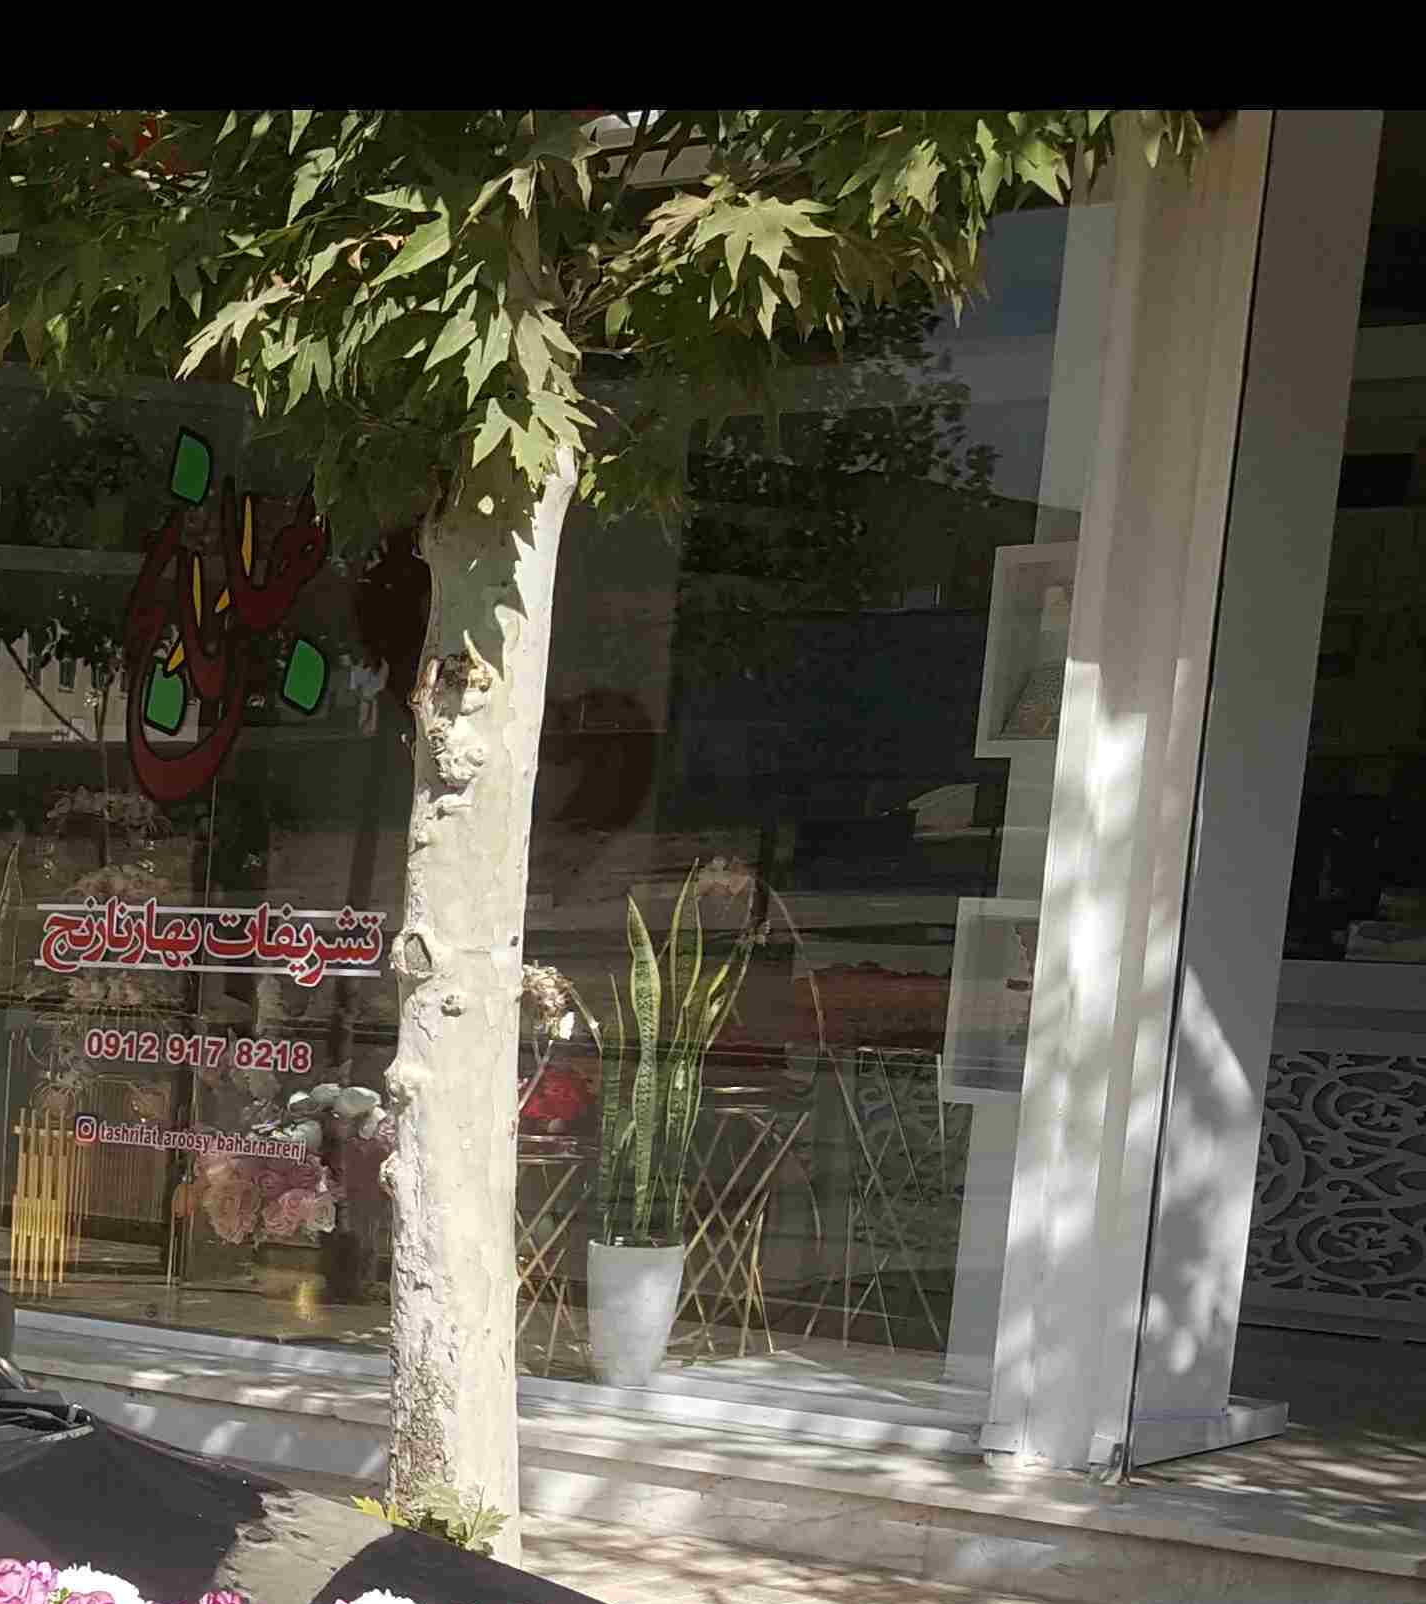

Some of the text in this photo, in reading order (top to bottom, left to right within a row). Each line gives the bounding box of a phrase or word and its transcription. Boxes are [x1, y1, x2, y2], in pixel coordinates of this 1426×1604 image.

[204, 903, 384, 987] تشریفات
[85, 1029, 312, 1073] 0912 917 8218
